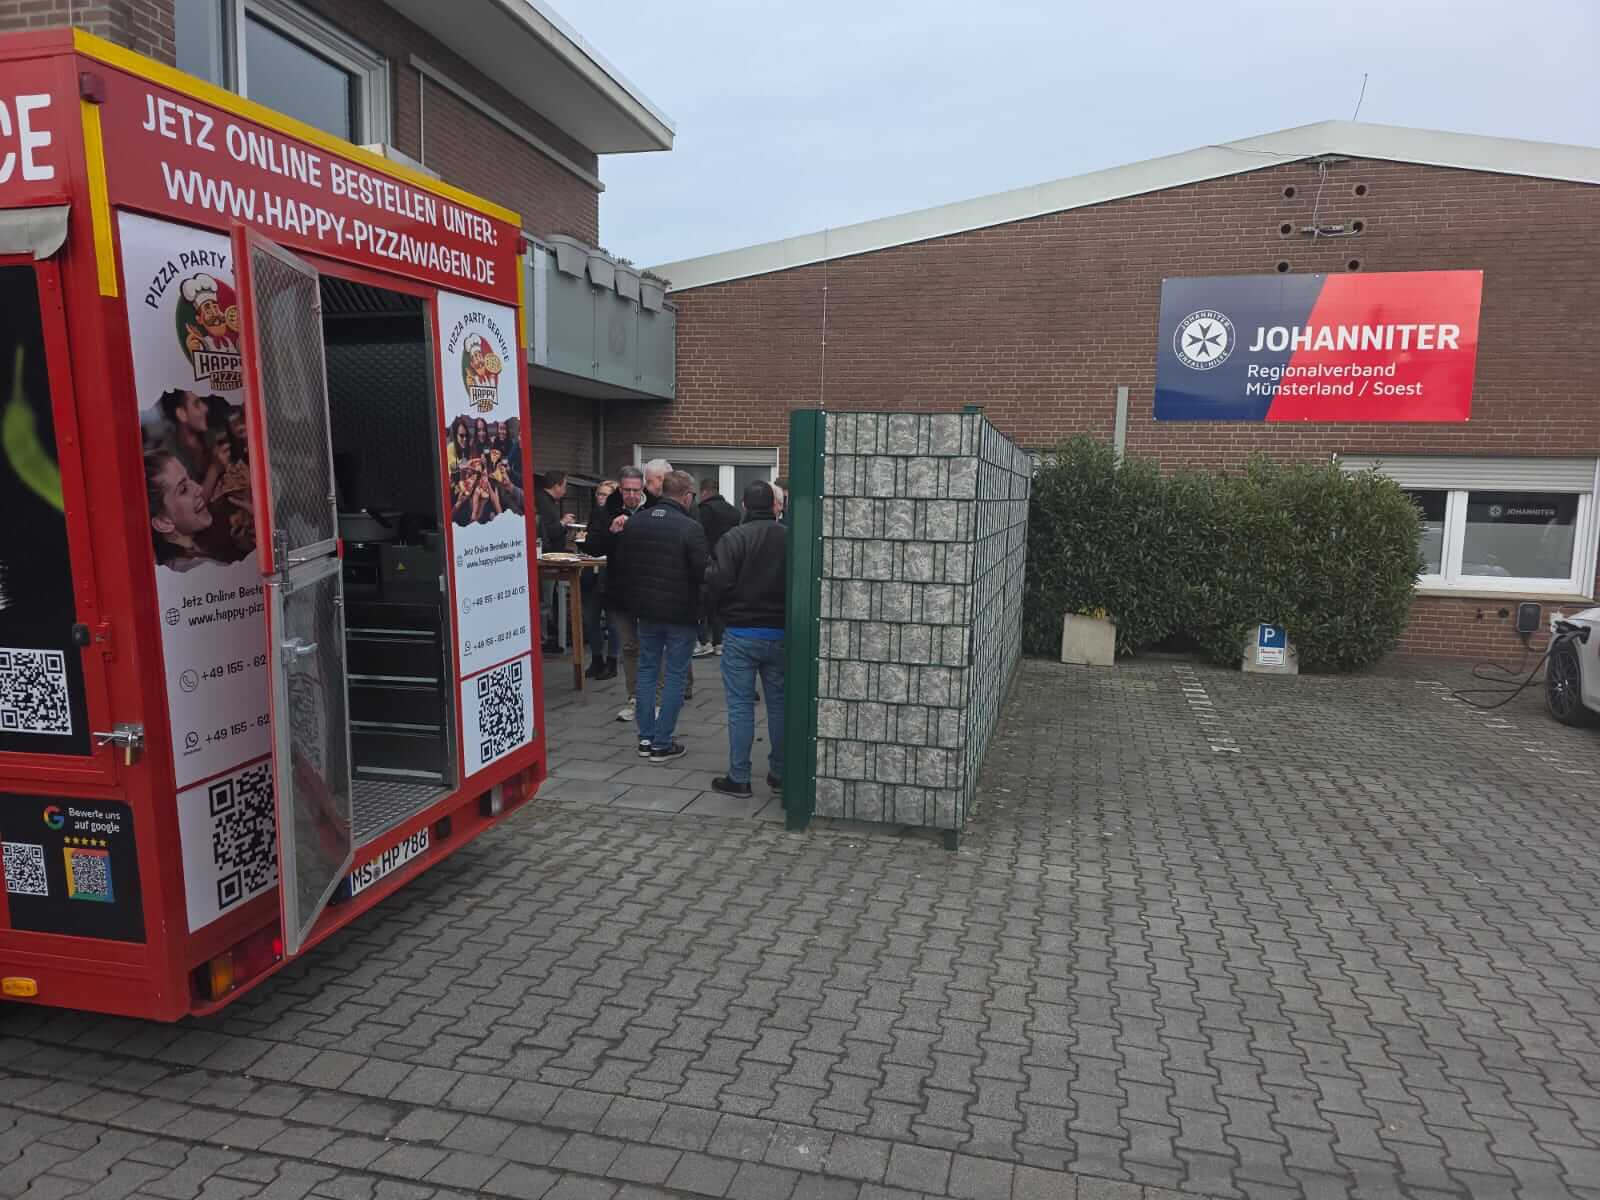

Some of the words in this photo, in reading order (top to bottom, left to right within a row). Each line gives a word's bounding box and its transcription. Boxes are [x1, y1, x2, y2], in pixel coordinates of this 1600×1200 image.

[142, 94, 216, 151] JETZ
[226, 123, 322, 188] ONLINE
[330, 162, 437, 227] BESTELLEN
[443, 205, 499, 246] UNTER:
[160, 161, 496, 286] WWW.HAPPY-PIZZAWAGEN.DE
[144, 260, 180, 309] PIZZA
[179, 249, 227, 270] PARTY
[447, 320, 465, 354] PIZZA
[463, 311, 486, 327] PARTY
[487, 318, 510, 361] SERVICE
[1249, 323, 1461, 352] JOHANNITER
[210, 371, 242, 382] PIZZ
[1247, 362, 1396, 382] Regionalverband
[472, 388, 495, 400] HAPPY
[1245, 380, 1354, 397] Münsterland
[1359, 381, 1369, 398] /
[1373, 382, 1424, 396] Soest
[1506, 508, 1555, 516] JOHANNITER
[182, 596, 202, 609] Jetz
[206, 589, 236, 604] Online
[1264, 628, 1276, 643] P
[201, 665, 224, 681] +49
[227, 660, 244, 675] 155
[205, 728, 228, 744] +49
[230, 720, 248, 736] 155
[68, 807, 104, 820] Bewerte
[104, 811, 121, 820] uns
[74, 820, 89, 830] auf
[90, 821, 121, 835] google
[351, 861, 373, 892] MS
[381, 846, 400, 873] HP
[404, 830, 428, 859] 786
